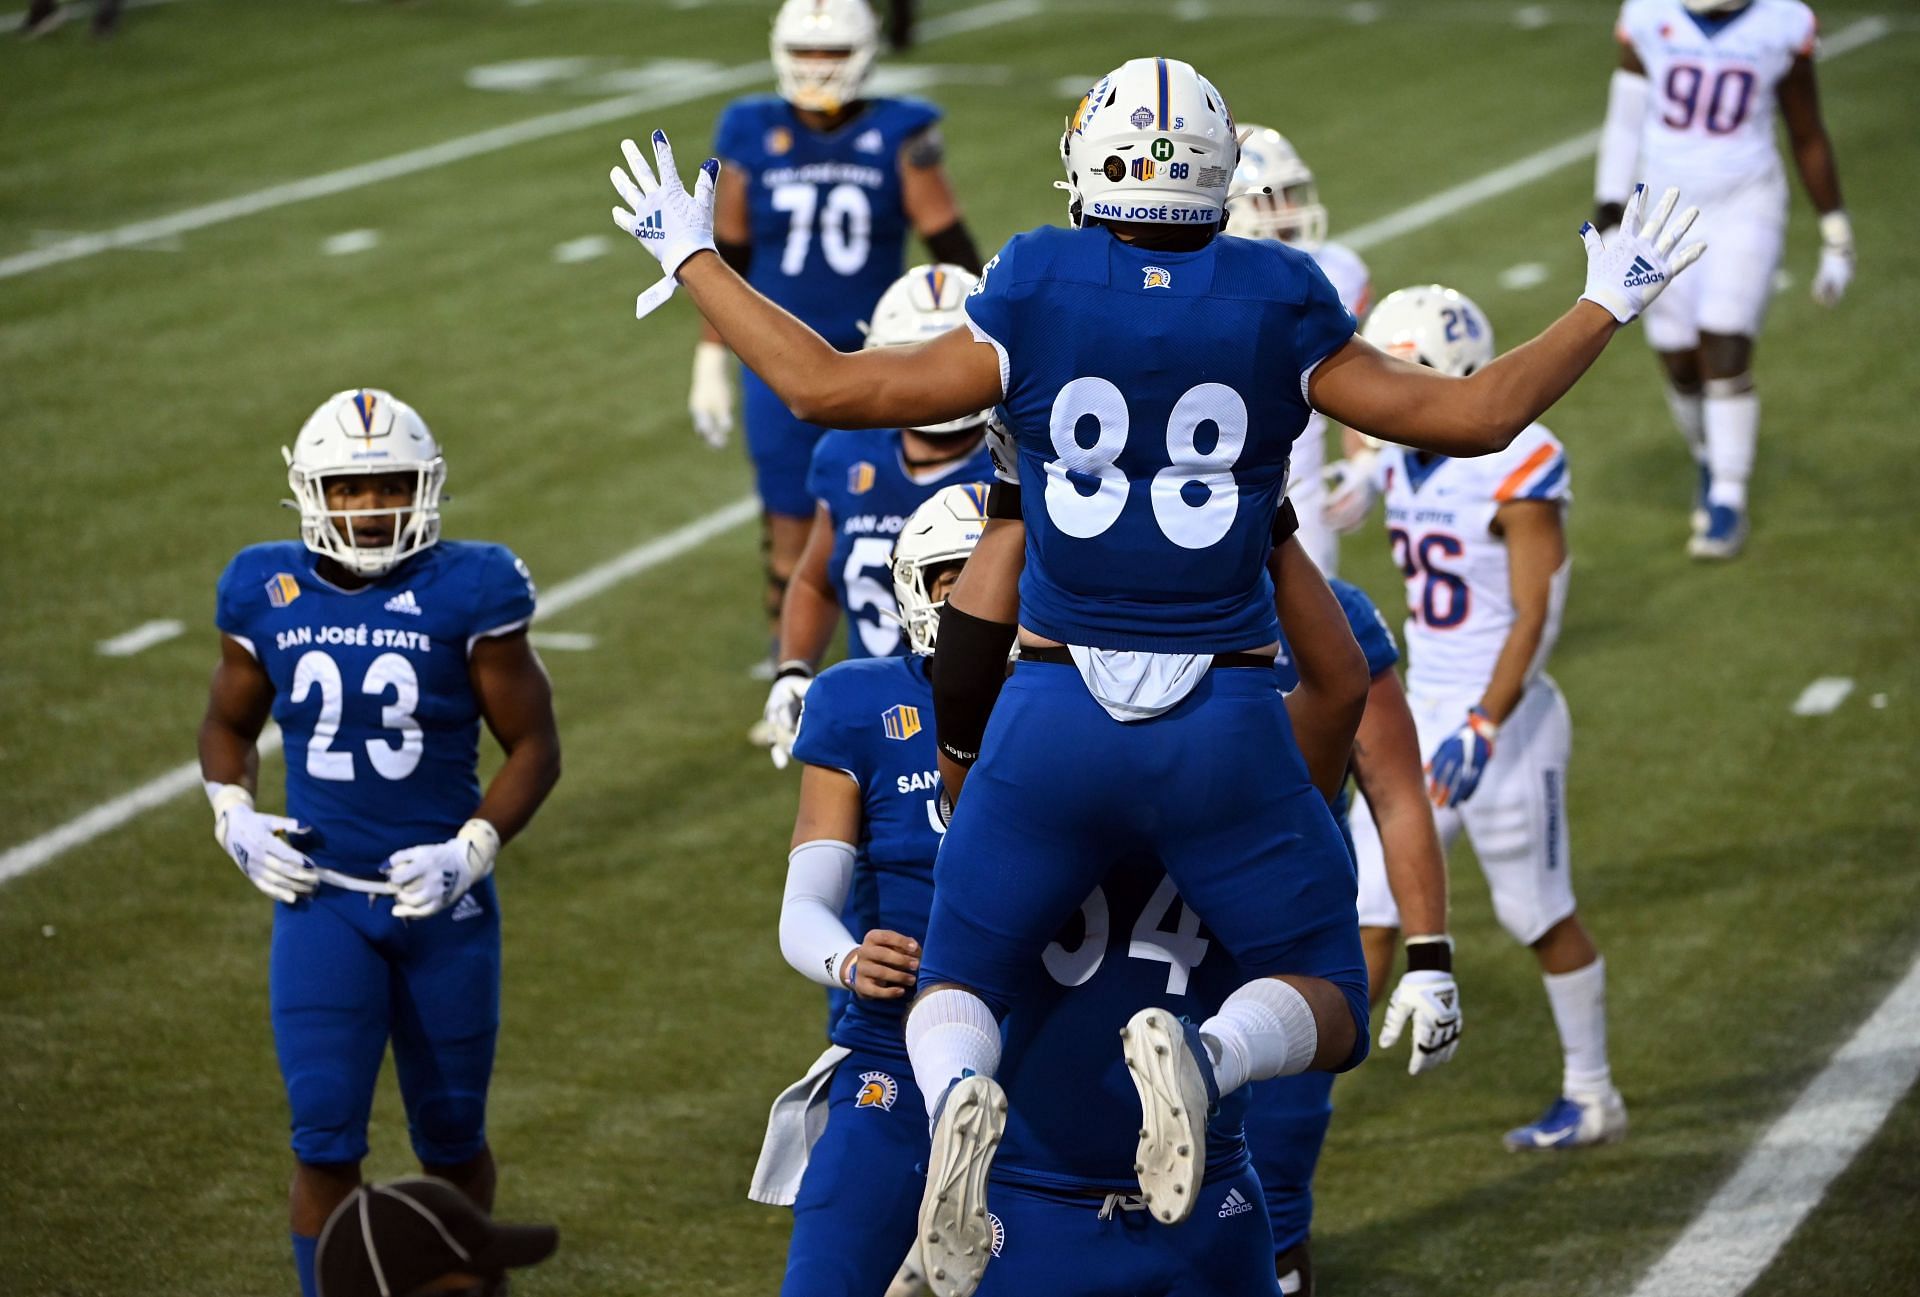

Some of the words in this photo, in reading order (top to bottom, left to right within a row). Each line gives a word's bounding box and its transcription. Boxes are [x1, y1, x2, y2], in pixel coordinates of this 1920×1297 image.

[1663, 64, 1757, 136] 90
[1155, 143, 1170, 157] H
[1169, 162, 1190, 180] 88
[1094, 203, 1121, 219] SAN
[1125, 205, 1168, 221] JOSÉ
[1171, 208, 1213, 222] STATE
[635, 228, 666, 240] adidas
[771, 182, 871, 276] 70
[1623, 271, 1665, 288] adidas
[1044, 376, 1248, 550] 88
[876, 515, 911, 534] JO
[276, 626, 312, 650] SAN
[315, 622, 369, 647] JOSÉ
[371, 628, 431, 653] STATE
[290, 650, 424, 781] 23
[897, 770, 941, 794] SAN
[1218, 1203, 1253, 1218] adidas
